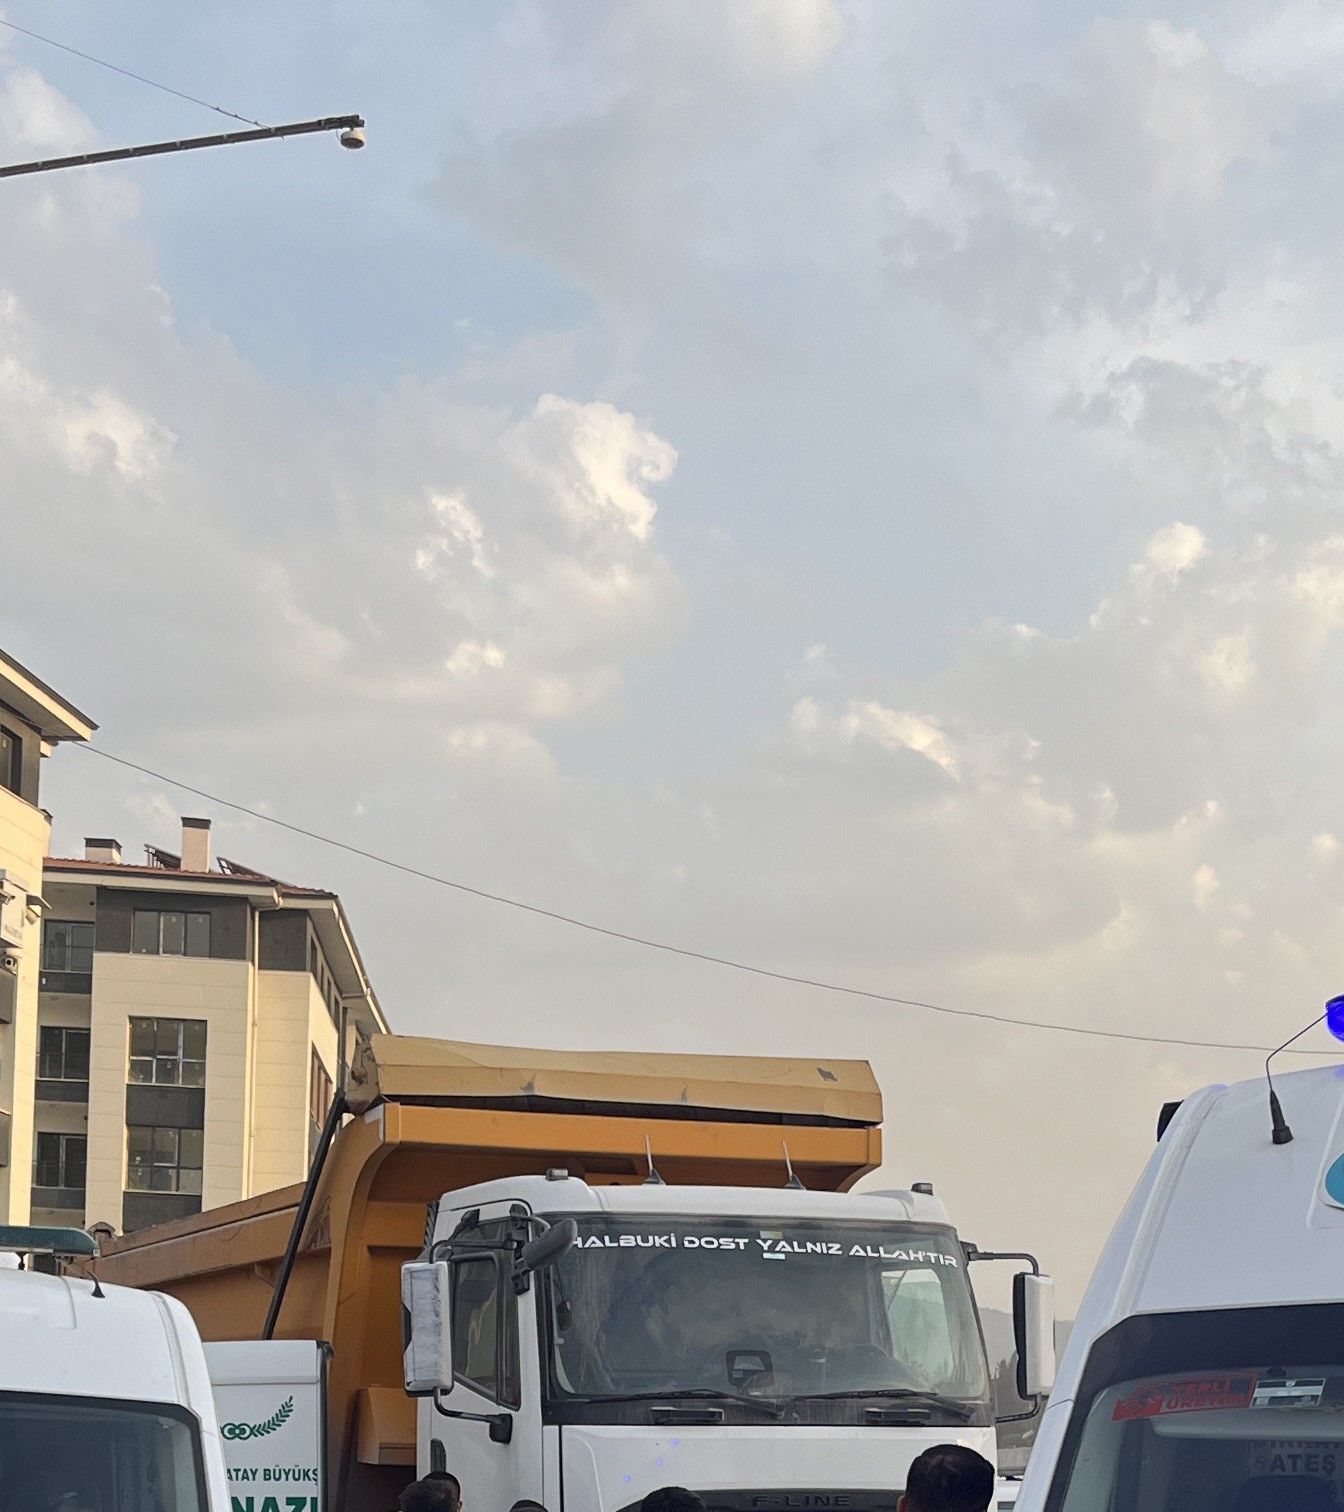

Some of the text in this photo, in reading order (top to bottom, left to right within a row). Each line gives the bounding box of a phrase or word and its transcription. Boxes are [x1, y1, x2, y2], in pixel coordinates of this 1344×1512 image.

[682, 1236, 750, 1251] DOST
[756, 1239, 844, 1256] YALNIZ
[848, 1244, 959, 1268] ALLAH'TIR
[751, 1495, 851, 1507] F-LINE
